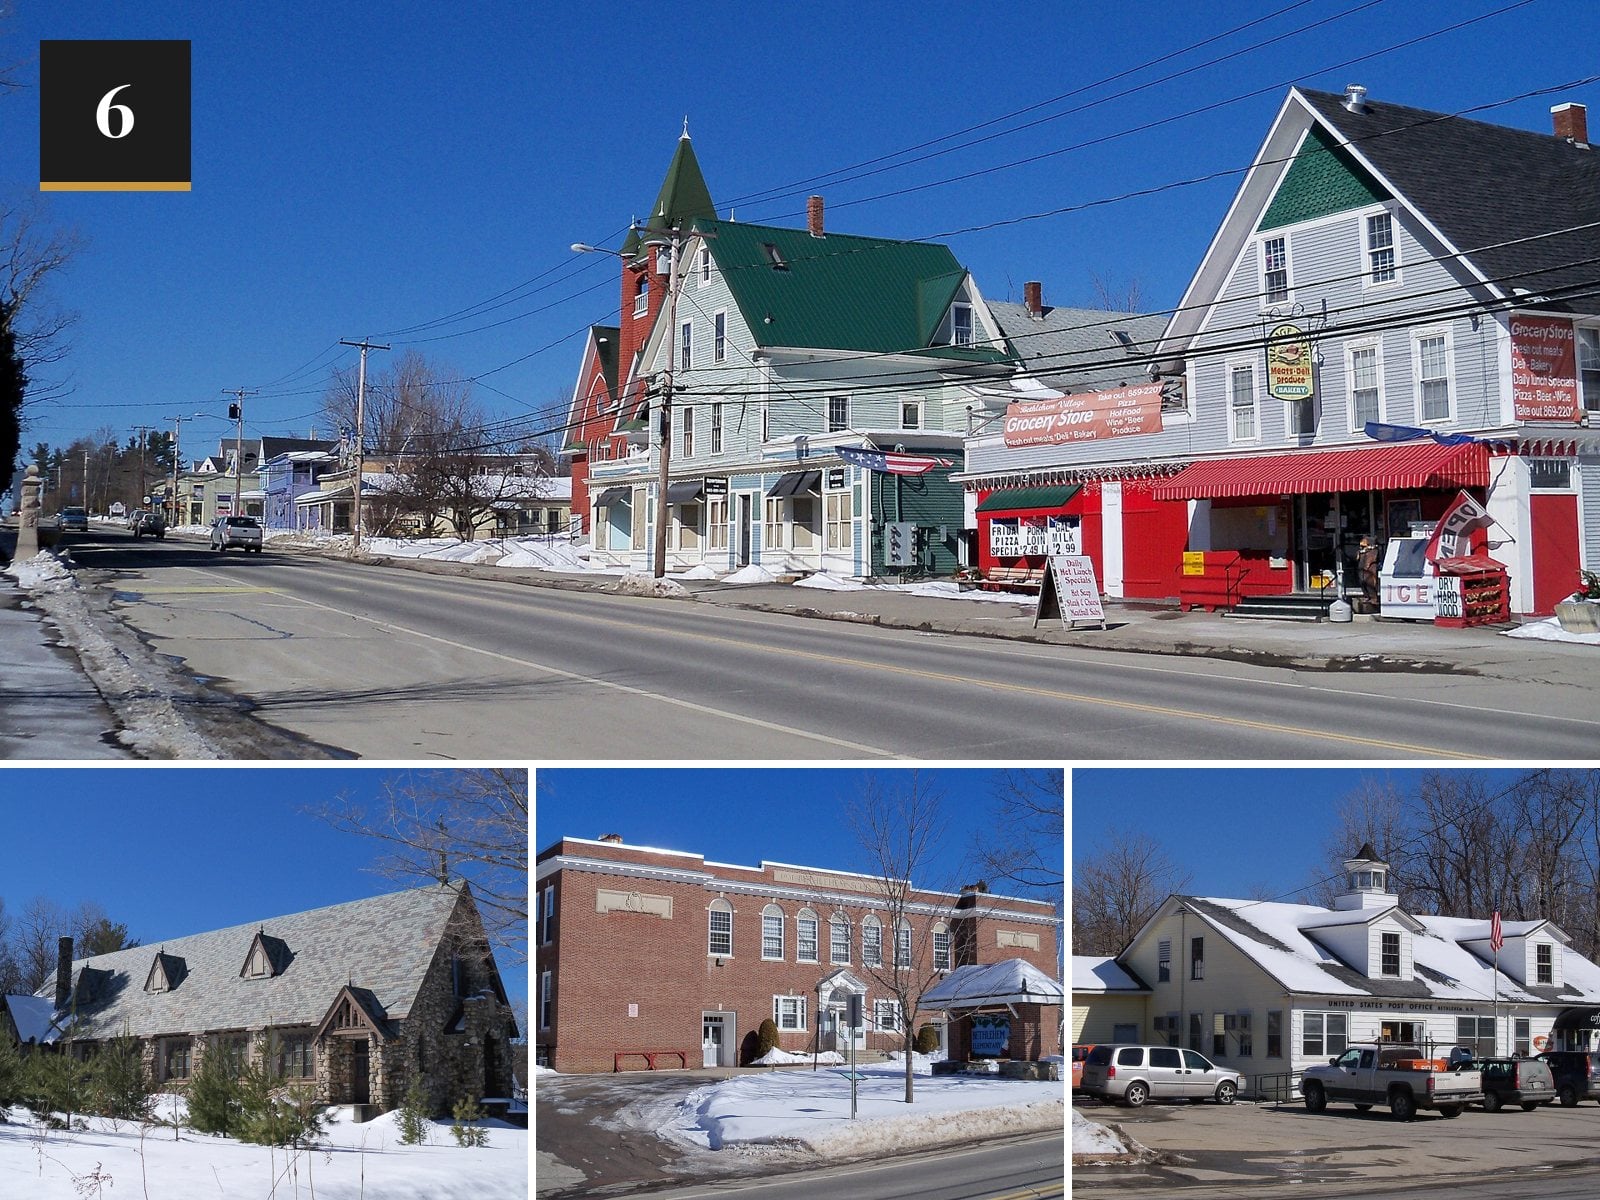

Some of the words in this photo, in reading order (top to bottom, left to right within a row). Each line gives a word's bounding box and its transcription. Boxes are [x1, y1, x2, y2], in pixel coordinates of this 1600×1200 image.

[1511, 322, 1549, 341] Grocery
[1549, 324, 1574, 340] Store
[1512, 343, 1531, 354] Fresh
[1532, 344, 1542, 355] cut
[1544, 346, 1563, 356] meats
[1512, 358, 1526, 369] Deli
[1530, 359, 1552, 373] Bakery
[1276, 376, 1306, 384] produce
[1513, 373, 1530, 387] Daily
[1531, 374, 1548, 386] lunch
[1548, 376, 1575, 388] Specials
[1278, 386, 1306, 394] BAKERY
[1098, 392, 1112, 401] Take
[1114, 392, 1125, 400] out
[1514, 389, 1532, 400] Pizza
[1536, 390, 1552, 402] Beer
[1555, 391, 1571, 402] Wine
[1020, 404, 1056, 414] Bethlehem
[1058, 399, 1086, 408] Village
[1118, 400, 1136, 408] Pizza
[1110, 409, 1122, 417] Hot
[1123, 407, 1142, 416] Food
[1515, 404, 1531, 416] Take
[1532, 406, 1542, 416] out
[1006, 413, 1057, 434] Grocery
[1058, 409, 1094, 427] Store
[1106, 418, 1124, 428] Wine
[1112, 426, 1140, 434] Produce
[1006, 436, 1022, 446] Fresh
[1024, 436, 1032, 444] cut
[1034, 434, 1054, 443] meats
[1074, 429, 1097, 440] Bakery
[1027, 526, 1046, 536] PORK
[1056, 524, 1070, 532] GAL
[996, 537, 1018, 546] PIZZA
[1026, 536, 1046, 546] LOIN
[1052, 533, 1074, 542] MILK
[992, 546, 1018, 556] SPECIA
[1066, 560, 1082, 568] Daily
[1074, 568, 1092, 576] Lunch
[1064, 576, 1092, 586] Specials
[1438, 577, 1454, 590] DRY
[1387, 584, 1429, 604] ICE
[1438, 590, 1458, 604] HARD
[1439, 604, 1458, 617] WOOD
[1328, 1000, 1354, 1008] UNITED
[1388, 1002, 1404, 1010] POST
